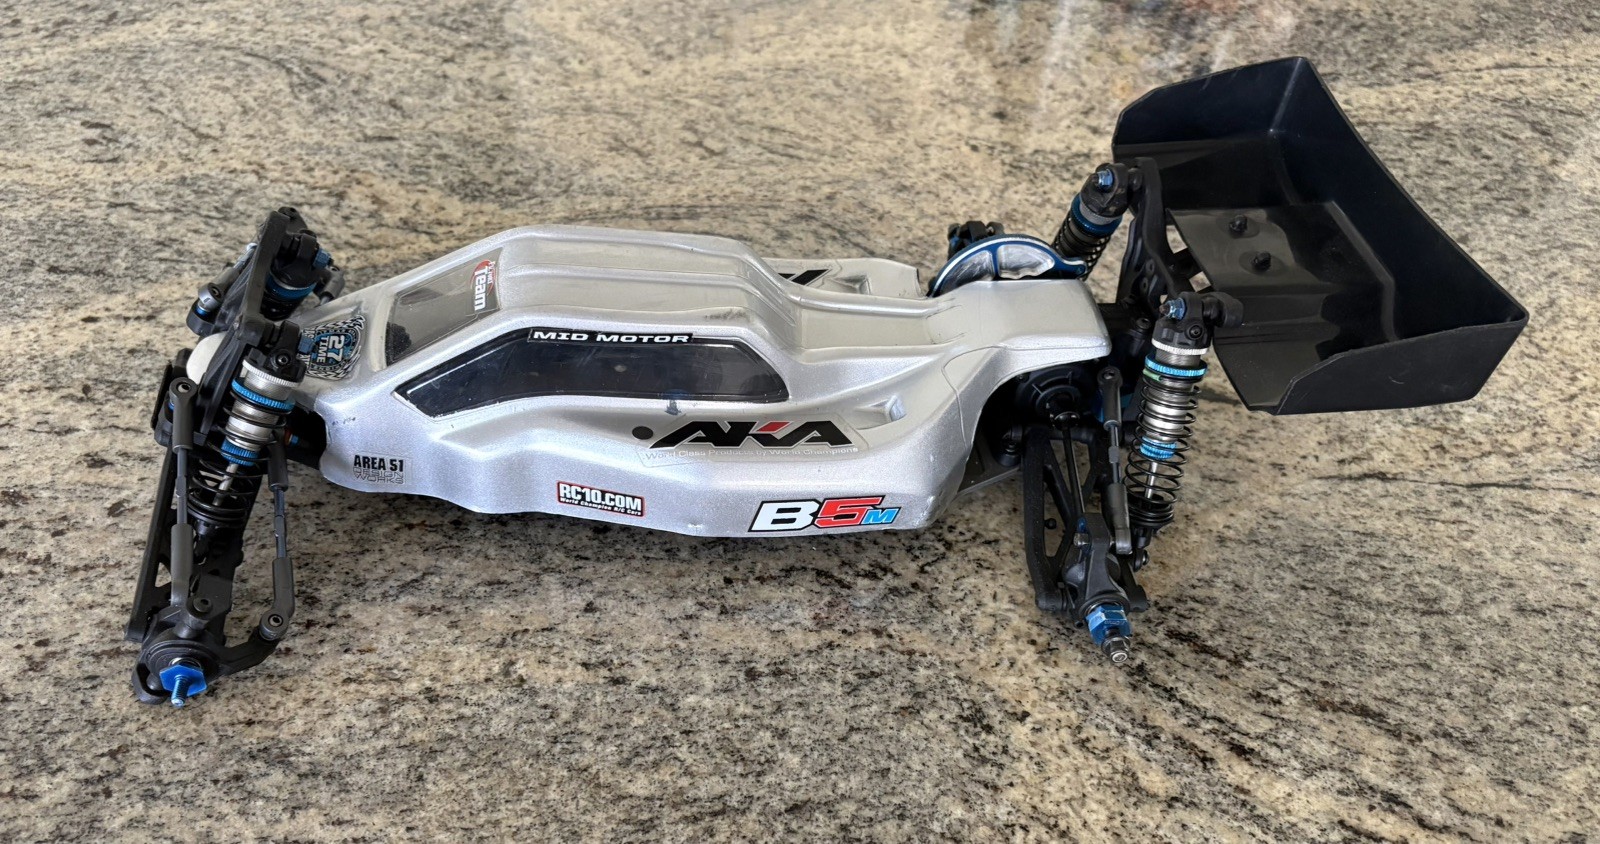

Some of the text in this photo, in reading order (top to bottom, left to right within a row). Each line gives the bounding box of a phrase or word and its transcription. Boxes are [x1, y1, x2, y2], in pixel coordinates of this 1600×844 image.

[474, 265, 488, 311] Team
[533, 331, 690, 343] MID MOTOR
[316, 335, 328, 363] TIME
[326, 334, 345, 362] 27
[649, 420, 853, 449] AKA
[353, 454, 403, 472] AREA 51
[645, 451, 676, 460] World
[679, 449, 705, 457] Class
[353, 466, 404, 479] DESIGN
[354, 473, 404, 485] WORKS
[559, 483, 642, 511] RC10.COM
[560, 497, 579, 505] World
[581, 500, 612, 510] Champion
[627, 508, 642, 516] Cars
